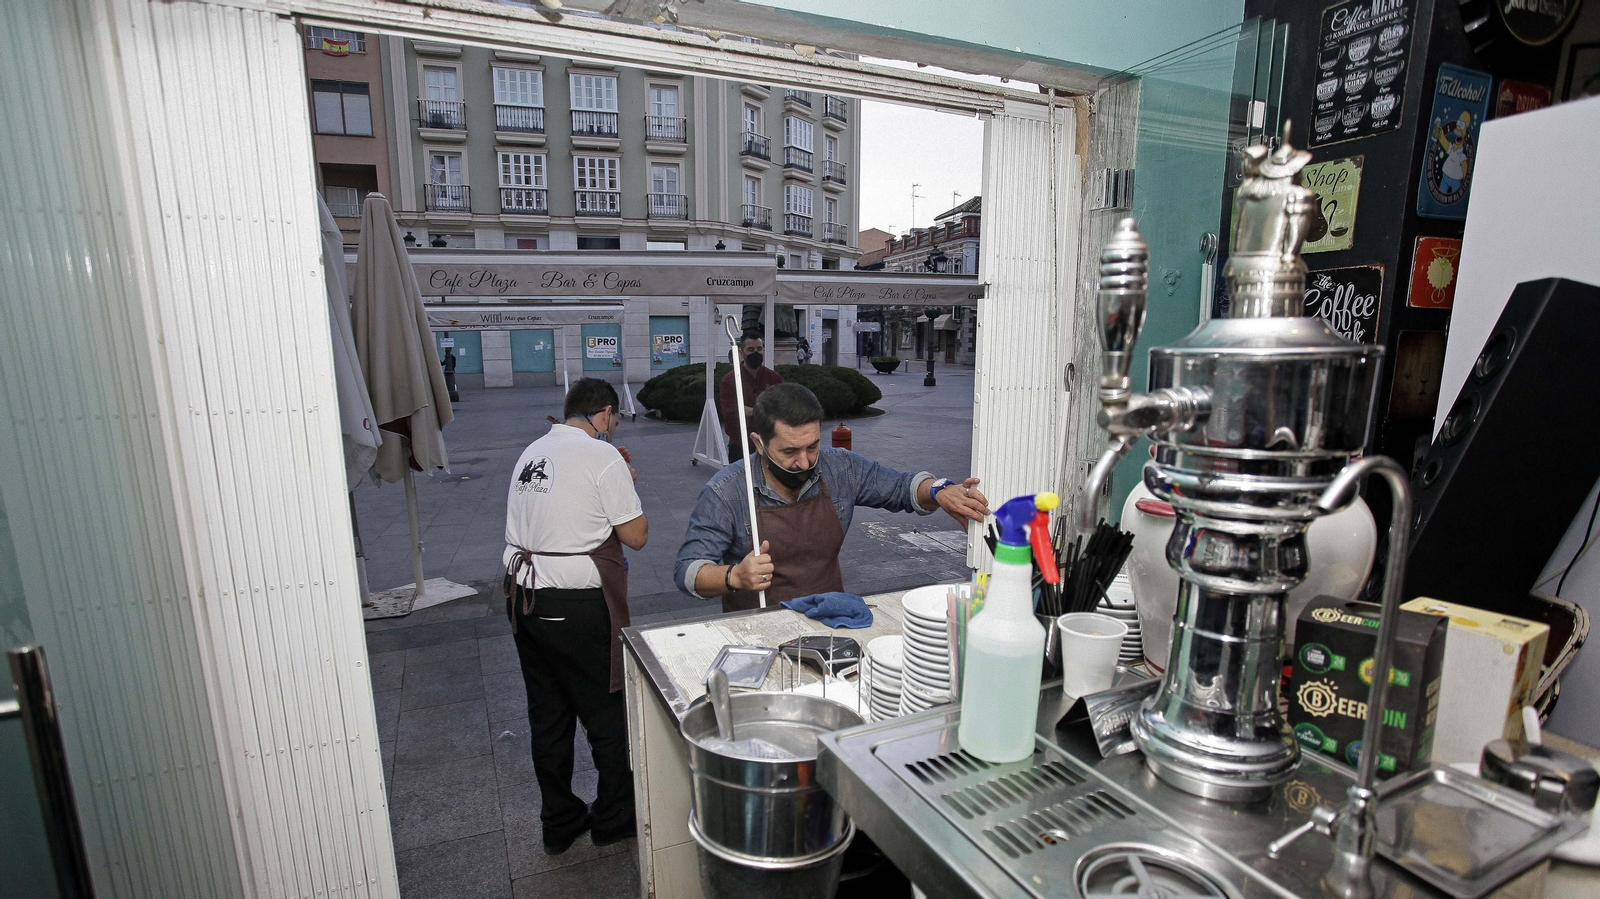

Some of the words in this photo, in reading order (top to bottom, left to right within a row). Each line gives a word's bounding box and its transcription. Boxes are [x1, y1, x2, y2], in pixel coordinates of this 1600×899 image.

[1331, 5, 1370, 31] Coffee
[1353, 20, 1370, 32] YOUR
[1371, 11, 1398, 26] COFFEE
[1306, 164, 1349, 195] Shop
[429, 269, 464, 294] Café
[468, 269, 519, 294] Plaza
[541, 270, 577, 289] Bar
[582, 273, 599, 289] &
[603, 271, 642, 293] Copas
[706, 276, 754, 288] Cruzcampo
[837, 286, 866, 302] Plaza
[878, 287, 900, 300] Bar
[914, 288, 937, 303] Copas
[1302, 283, 1375, 331] Coffee
[597, 338, 616, 346] PRO
